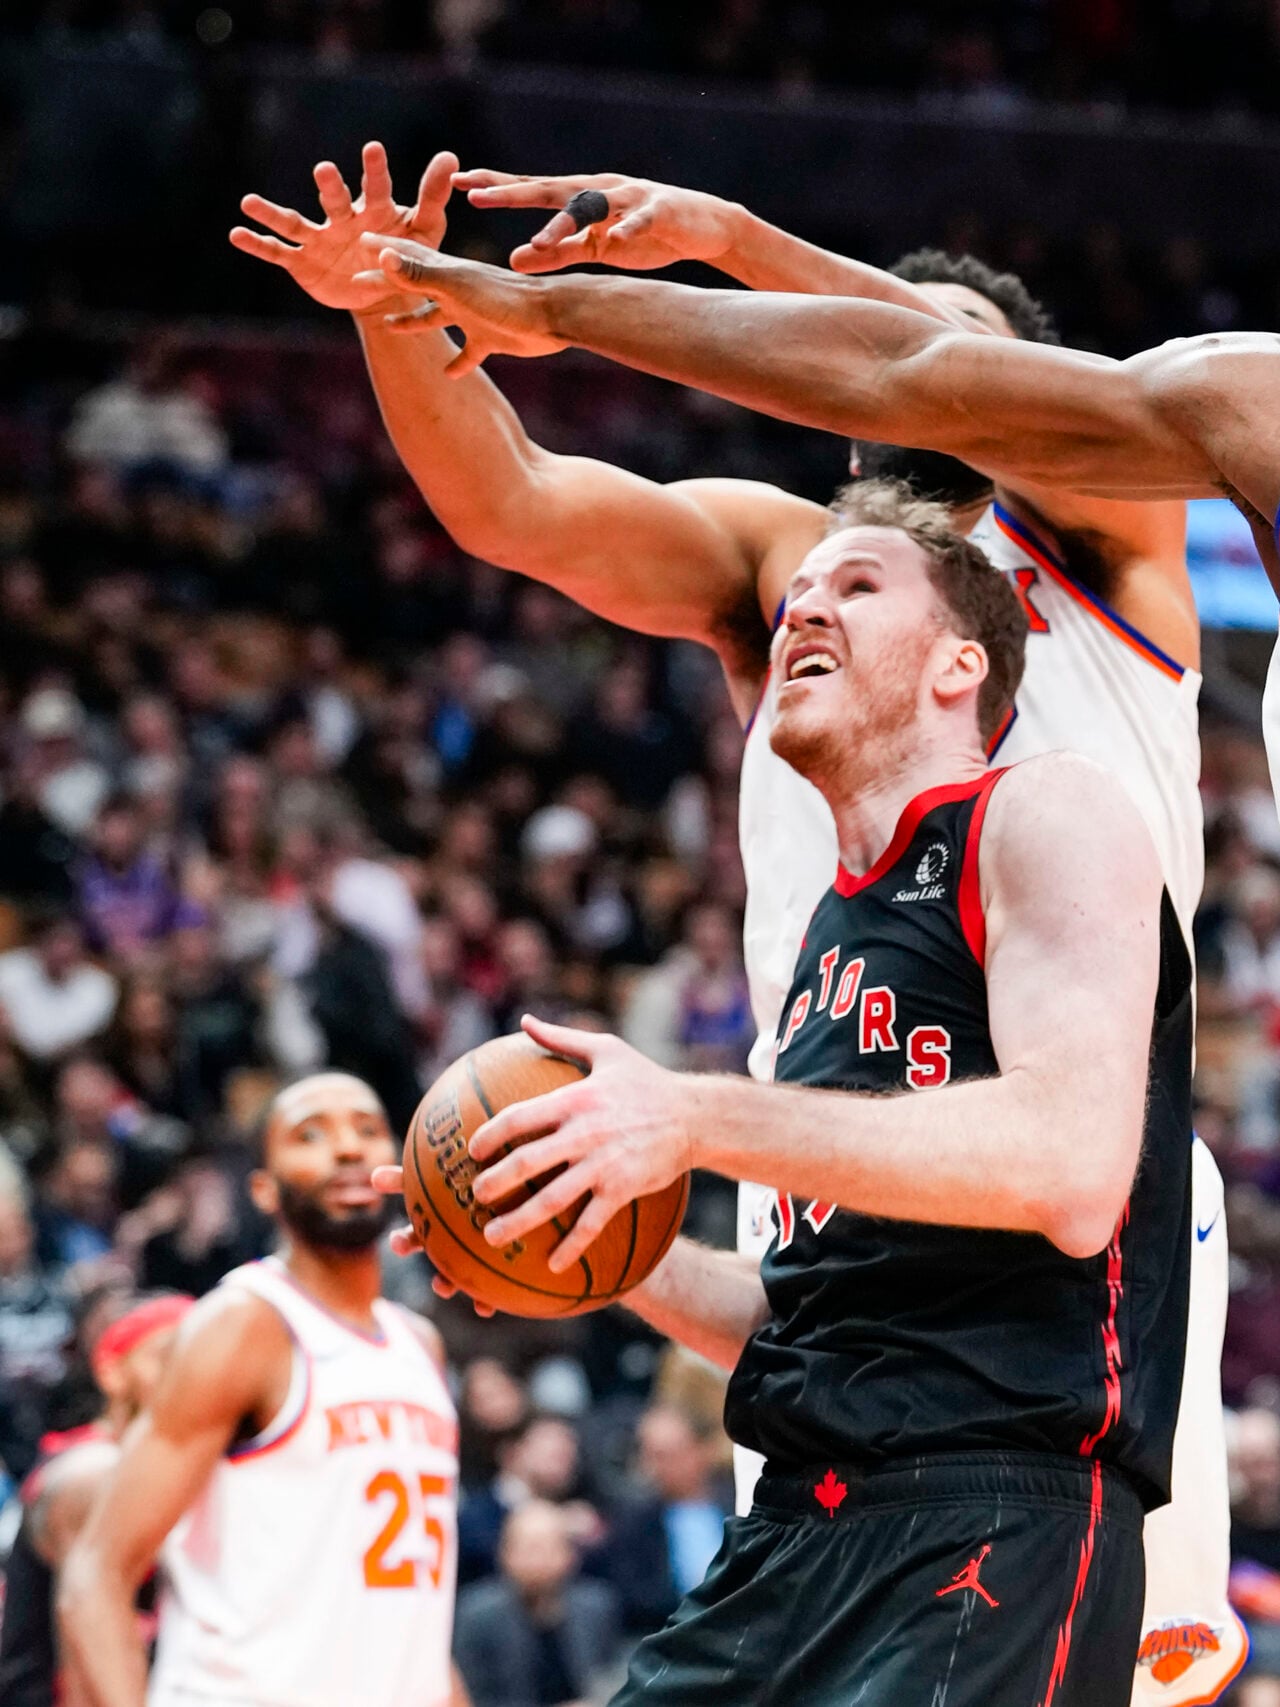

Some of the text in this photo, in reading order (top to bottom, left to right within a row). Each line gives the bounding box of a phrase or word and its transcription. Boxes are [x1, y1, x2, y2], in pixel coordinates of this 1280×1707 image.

[891, 883, 946, 902] Sun Life
[771, 944, 952, 1091] PTORS
[362, 1469, 453, 1589] 25
